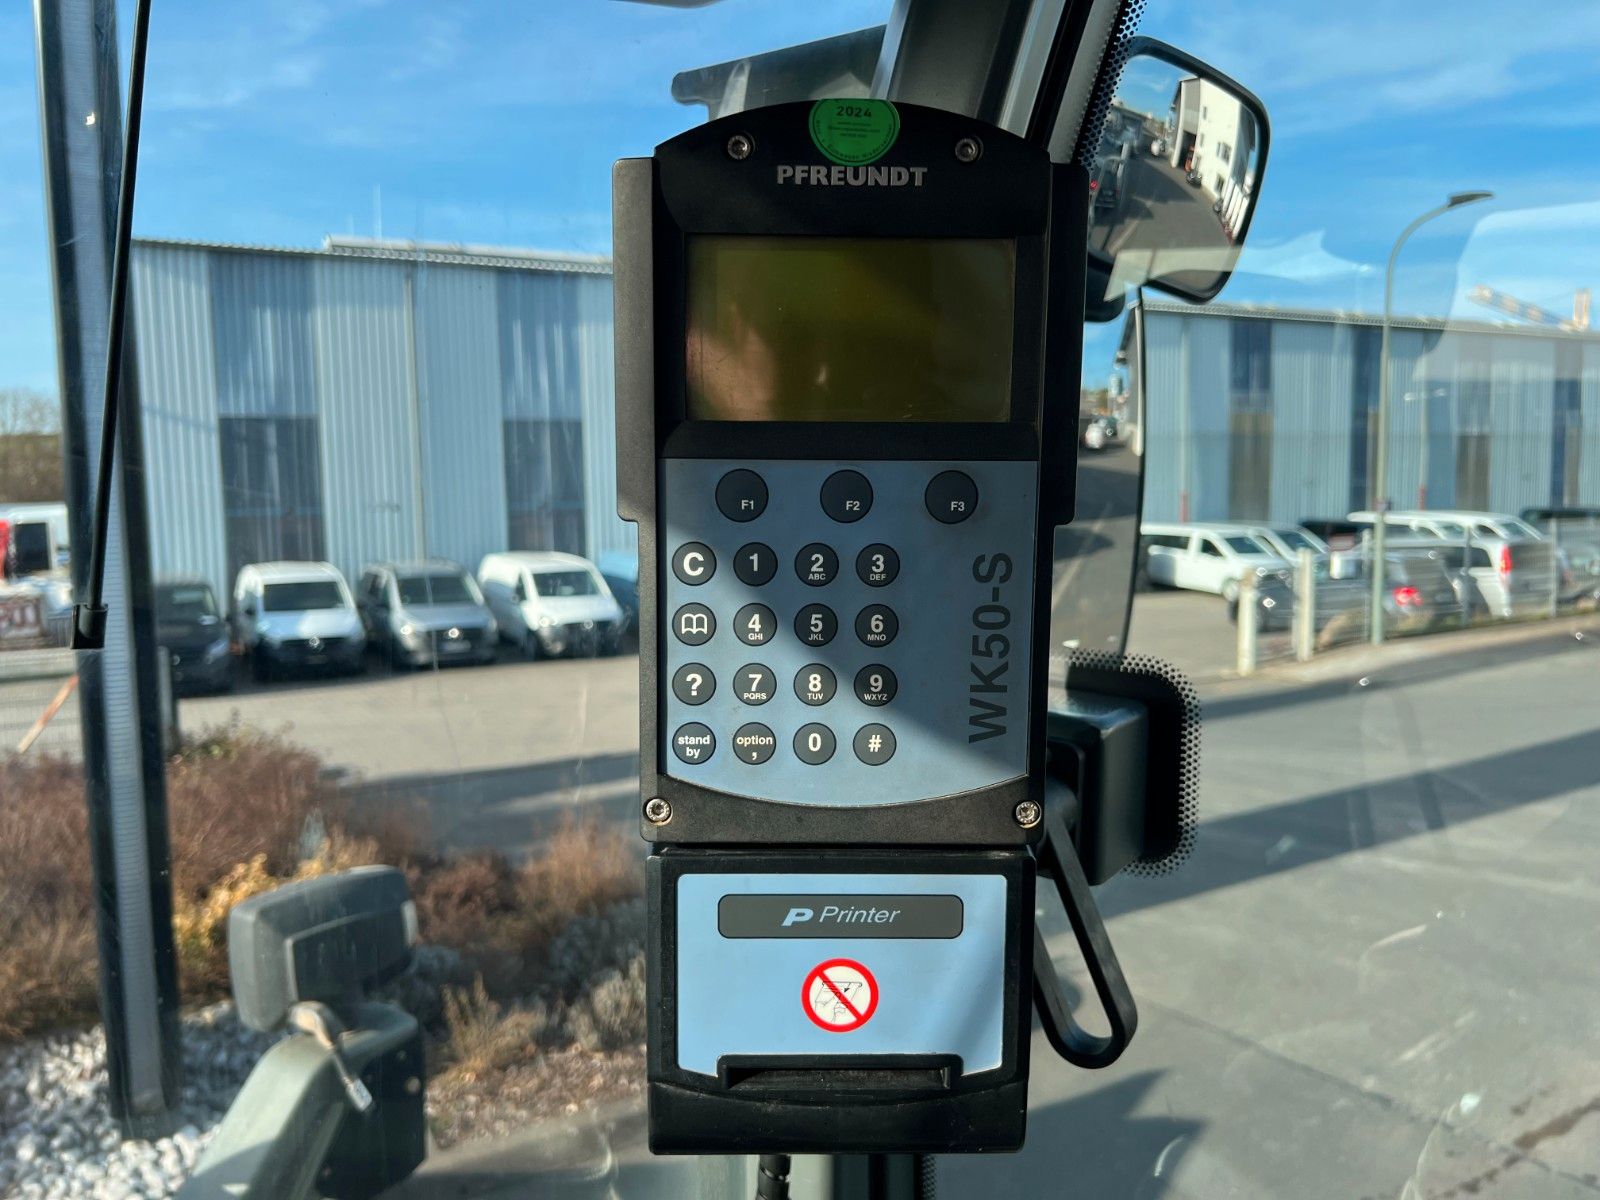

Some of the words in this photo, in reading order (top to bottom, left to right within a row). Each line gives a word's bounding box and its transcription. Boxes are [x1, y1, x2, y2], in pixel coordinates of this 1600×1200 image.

[836, 105, 872, 118] 2024
[776, 165, 928, 187] PFREUNDT
[741, 500, 755, 511] F1
[845, 501, 861, 512] F2
[950, 501, 966, 512] F3
[682, 552, 705, 577] C
[748, 553, 759, 572] 1
[810, 553, 825, 573] 2
[871, 554, 886, 574] 3
[808, 573, 826, 581] ABC
[869, 573, 887, 581] DEF
[747, 613, 762, 633] 4
[809, 614, 824, 634] 5
[869, 615, 884, 634] 6
[748, 633, 764, 641] GHI
[808, 633, 825, 642] JKL
[867, 633, 887, 642] MNO
[967, 552, 1014, 744] WK50-S
[748, 673, 763, 693] 7
[807, 673, 823, 693] 8
[868, 674, 884, 694] 9
[743, 692, 767, 700] PQRS
[807, 692, 825, 700] TUV
[863, 693, 889, 702] WXYZ
[677, 734, 711, 746] stand
[736, 735, 774, 747] option
[807, 733, 822, 752] 0
[685, 747, 701, 759] by
[819, 906, 901, 924] Printer
